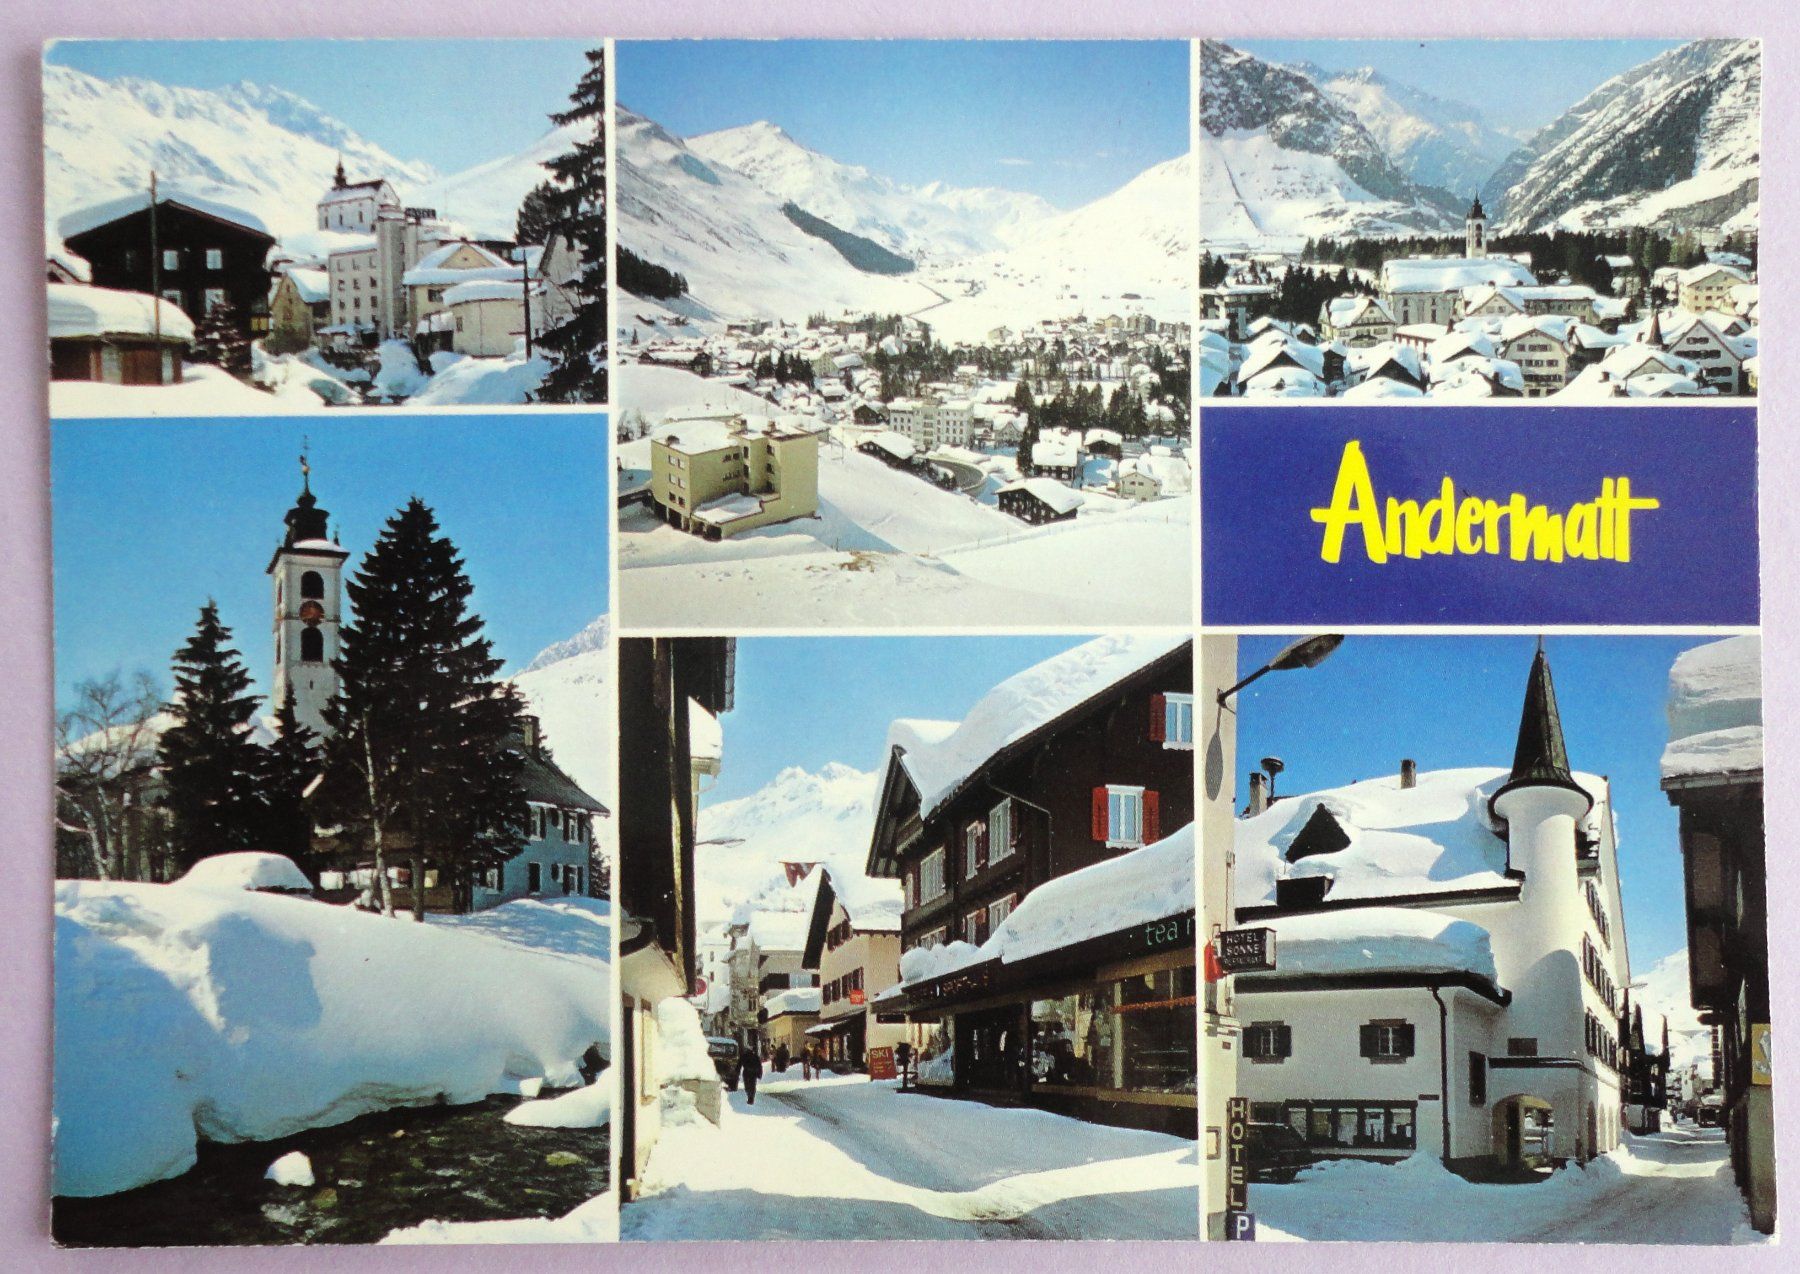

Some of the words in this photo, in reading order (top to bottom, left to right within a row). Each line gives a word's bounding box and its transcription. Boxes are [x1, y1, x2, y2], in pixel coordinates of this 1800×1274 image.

[1311, 440, 1660, 563] Andermatt
[1144, 920, 1178, 946] tea
[1226, 932, 1259, 944] HOTEL
[1226, 943, 1259, 956] SONNE
[871, 1049, 890, 1059] SKI
[1231, 1100, 1245, 1207] HOTEL
[1236, 1215, 1250, 1240] P
